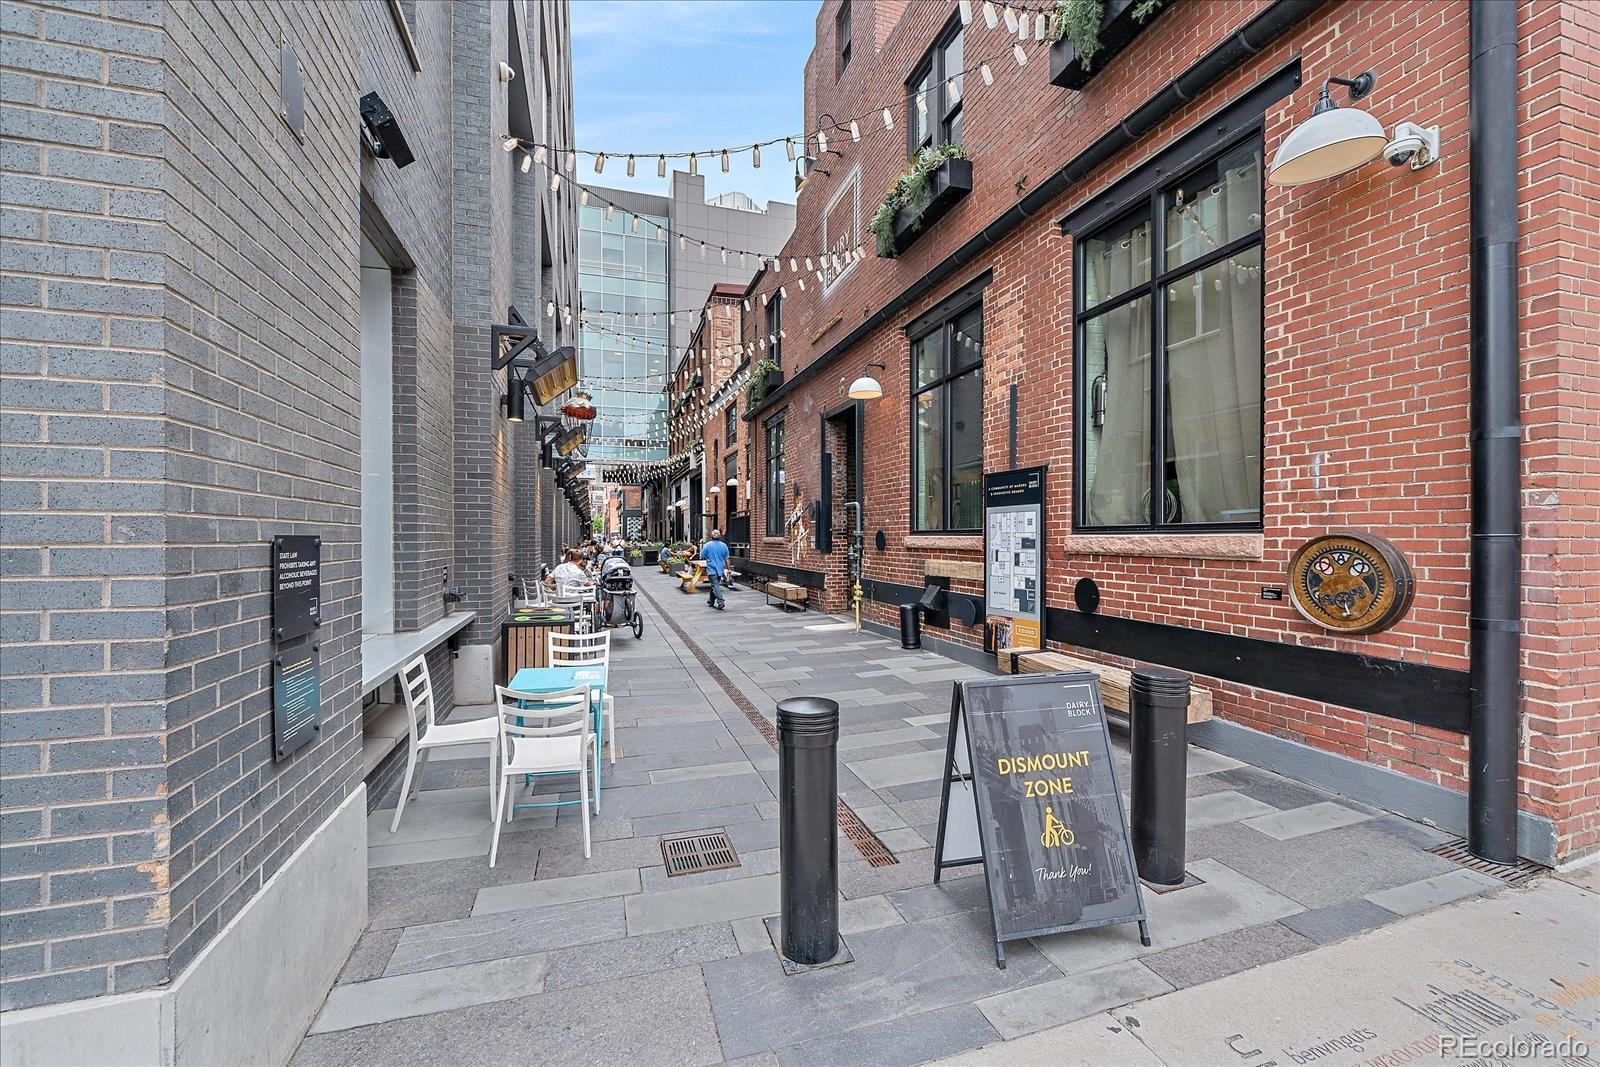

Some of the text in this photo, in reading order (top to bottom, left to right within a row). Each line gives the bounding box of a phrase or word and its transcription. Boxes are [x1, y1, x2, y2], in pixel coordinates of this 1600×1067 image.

[828, 250, 851, 286] BLC
[279, 562, 298, 570] PROHIBITS
[279, 571, 300, 580] ALCOHOLIC
[279, 582, 294, 590] BEYOND
[1066, 701, 1089, 709] DAIRY
[1067, 709, 1092, 717] BLOCK
[998, 750, 1089, 775] DISMOUNT
[1024, 777, 1073, 798] ZONE
[1036, 863, 1092, 882] Thank You!
[1281, 1028, 1378, 1065] benvinguts
